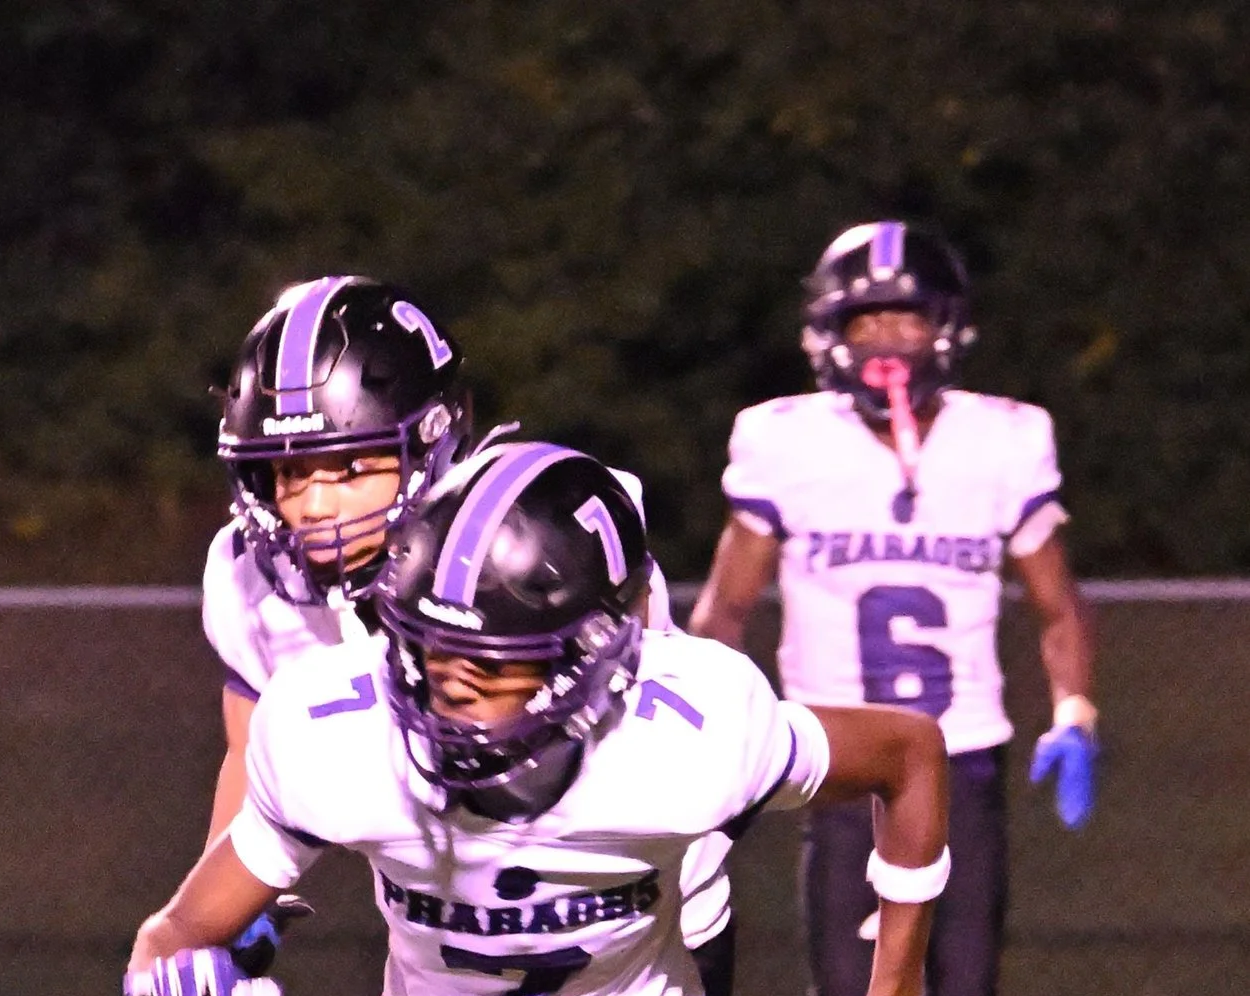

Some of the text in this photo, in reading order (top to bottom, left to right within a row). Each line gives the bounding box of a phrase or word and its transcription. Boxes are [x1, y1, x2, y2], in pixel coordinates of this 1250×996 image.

[392, 301, 452, 369] 2
[857, 586, 954, 720] 6
[308, 673, 377, 720] 7
[634, 679, 705, 731] 7
